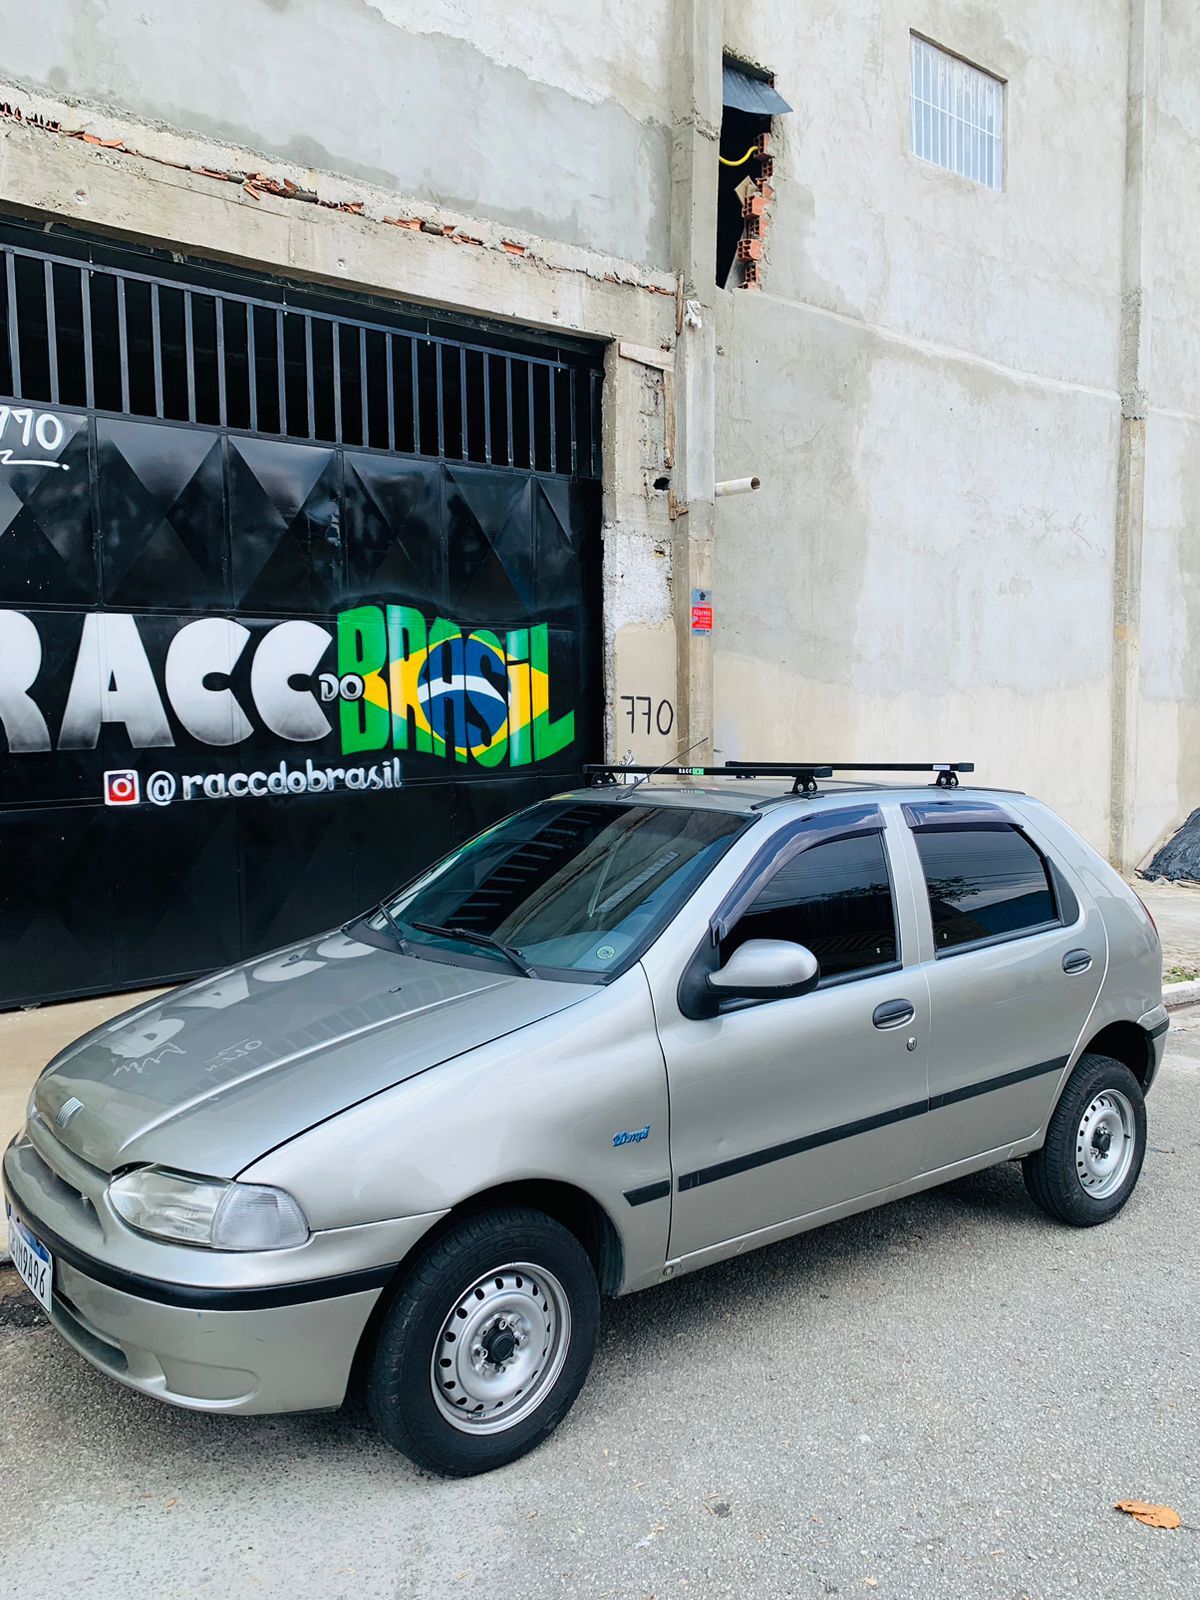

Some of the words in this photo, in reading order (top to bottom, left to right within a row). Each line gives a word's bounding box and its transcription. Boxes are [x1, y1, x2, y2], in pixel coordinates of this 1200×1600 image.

[318, 673, 364, 702] DO
[620, 696, 674, 735] 770
[146, 757, 402, 806] @raccdobrasil
